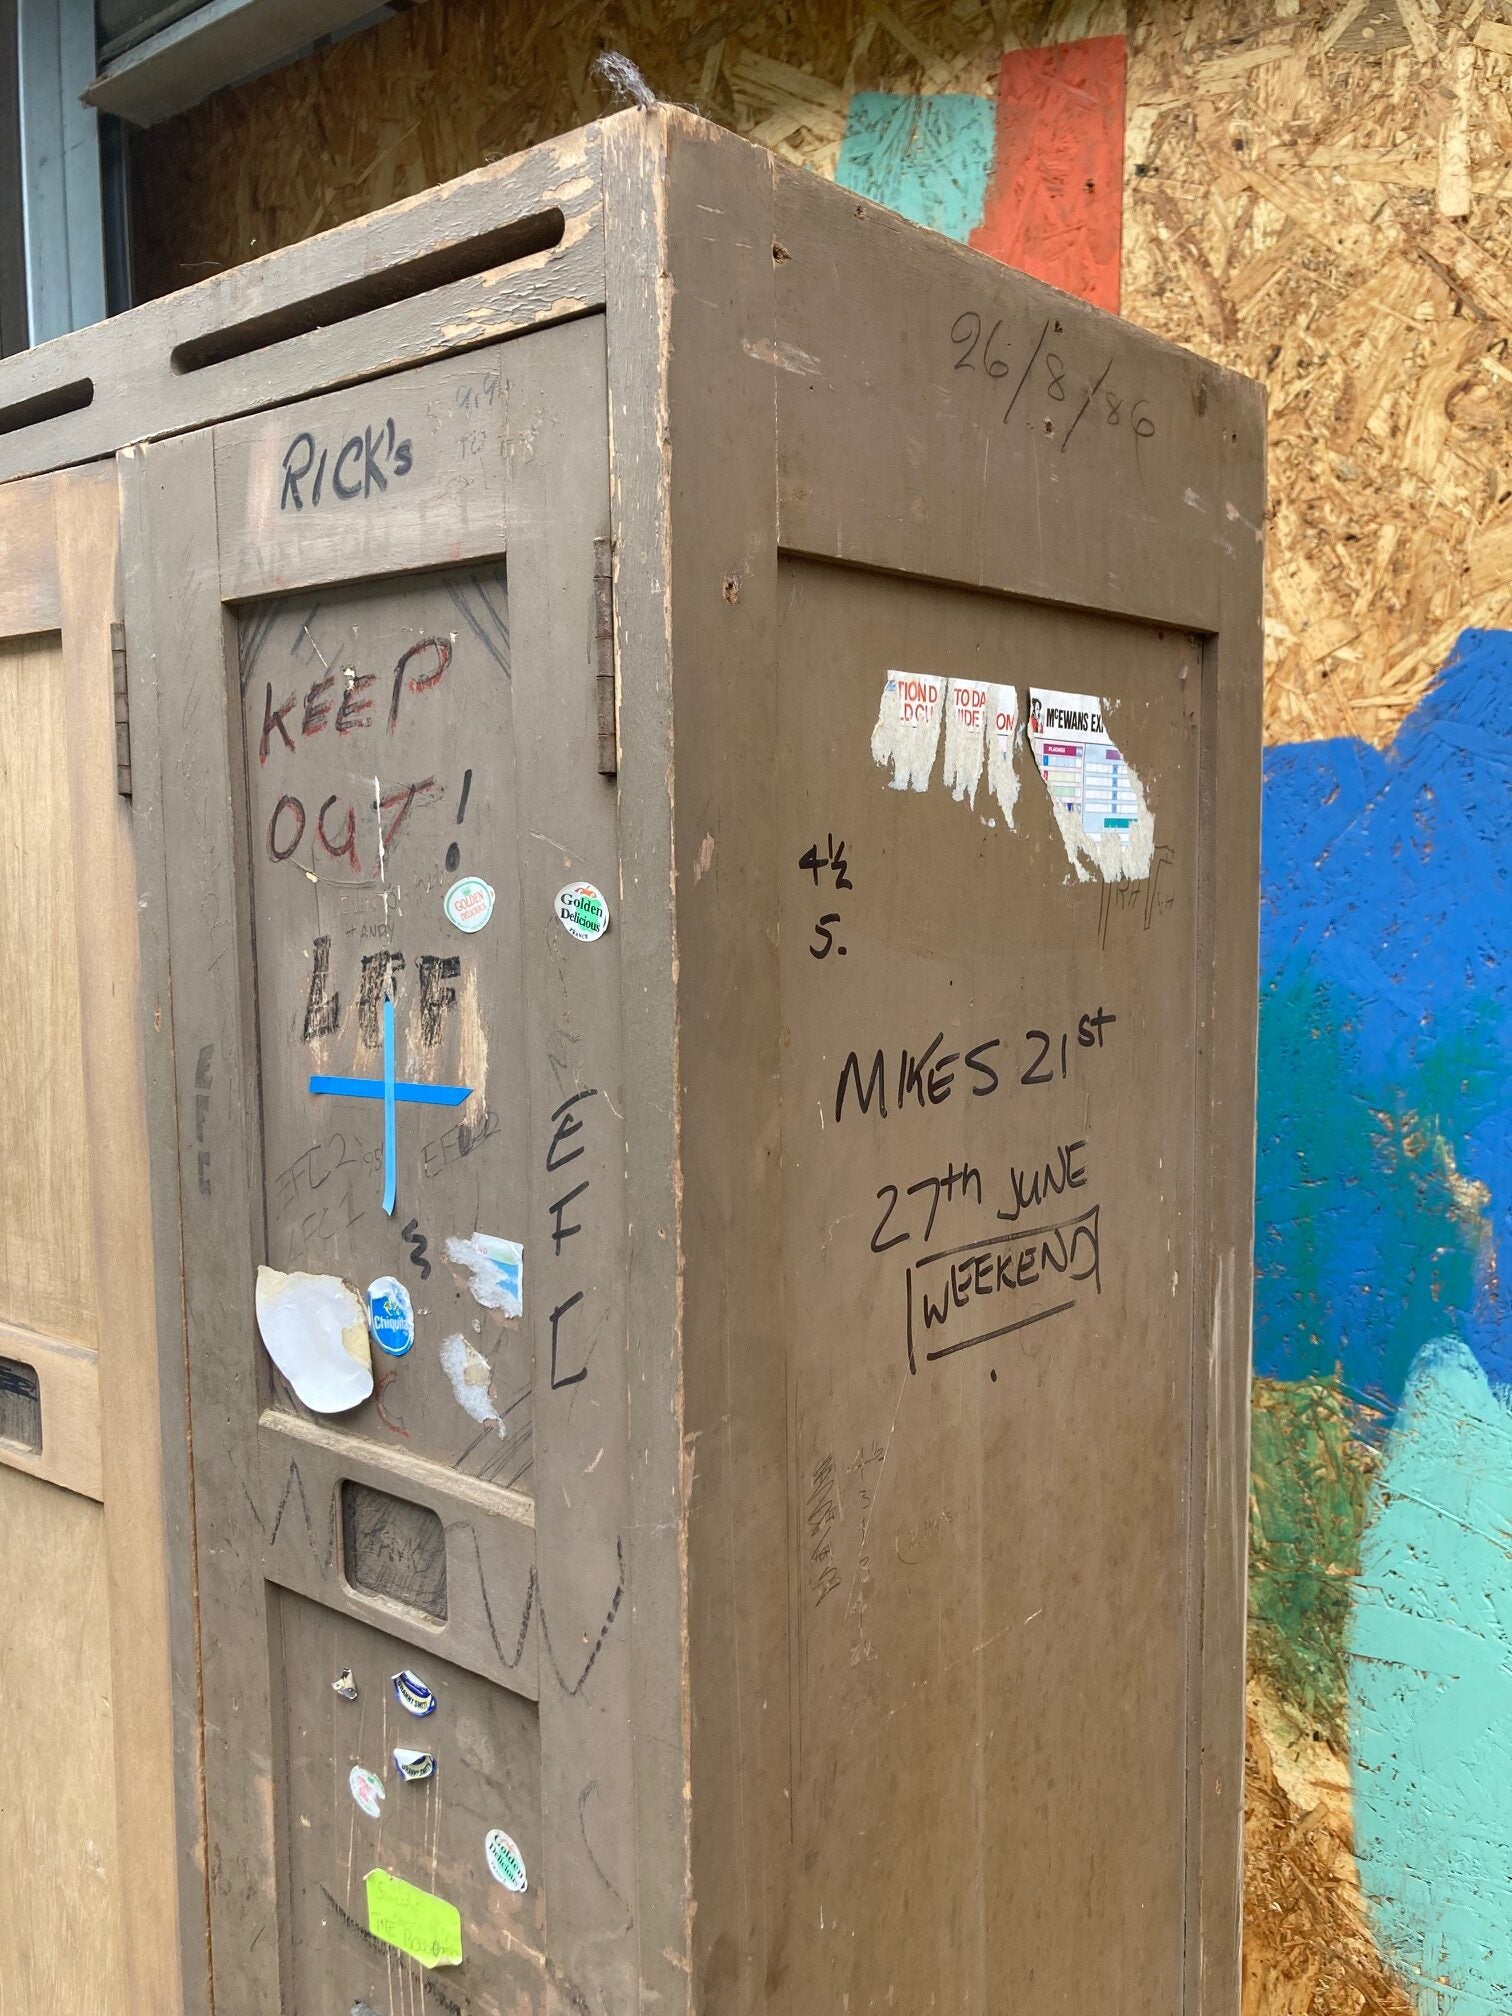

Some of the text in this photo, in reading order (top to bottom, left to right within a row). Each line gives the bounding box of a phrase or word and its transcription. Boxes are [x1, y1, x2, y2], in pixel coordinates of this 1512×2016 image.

[951, 311, 1155, 453] 26/8/86
[259, 637, 453, 766] KEEP
[454, 890, 484, 912] GOLDEN
[560, 893, 603, 918] Golden
[560, 907, 601, 933] Delicious
[835, 1006, 1117, 1123] MIKES 21st
[871, 1140, 1087, 1253] 27th JUNE
[923, 1225, 1098, 1329] WEEKEND
[489, 1843, 518, 1887] Delicious
[494, 1834, 524, 1879] Golden
